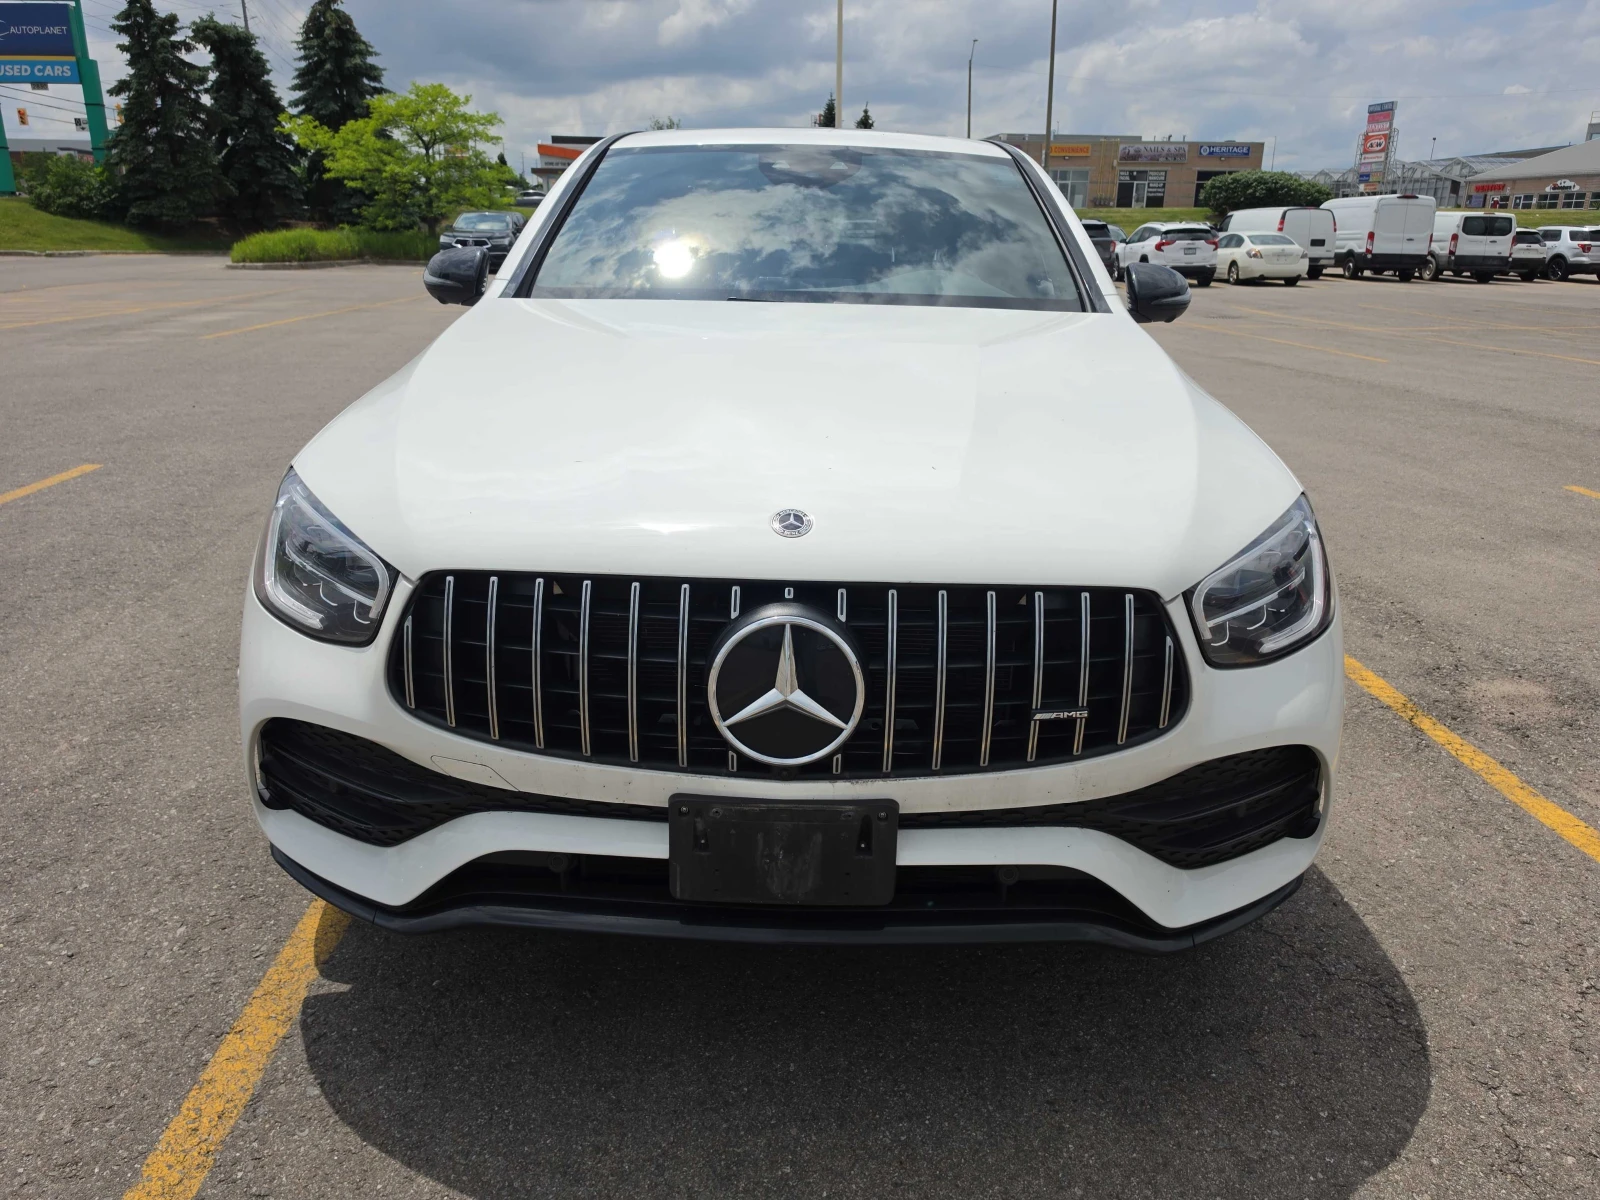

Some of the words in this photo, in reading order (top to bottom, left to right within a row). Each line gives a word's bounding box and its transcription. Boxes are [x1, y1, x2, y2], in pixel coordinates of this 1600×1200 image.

[9, 26, 67, 35] AUTOPLANET
[34, 65, 71, 77] CARS
[1054, 146, 1089, 154] CONVENIENCE
[1050, 711, 1089, 719] AMG
